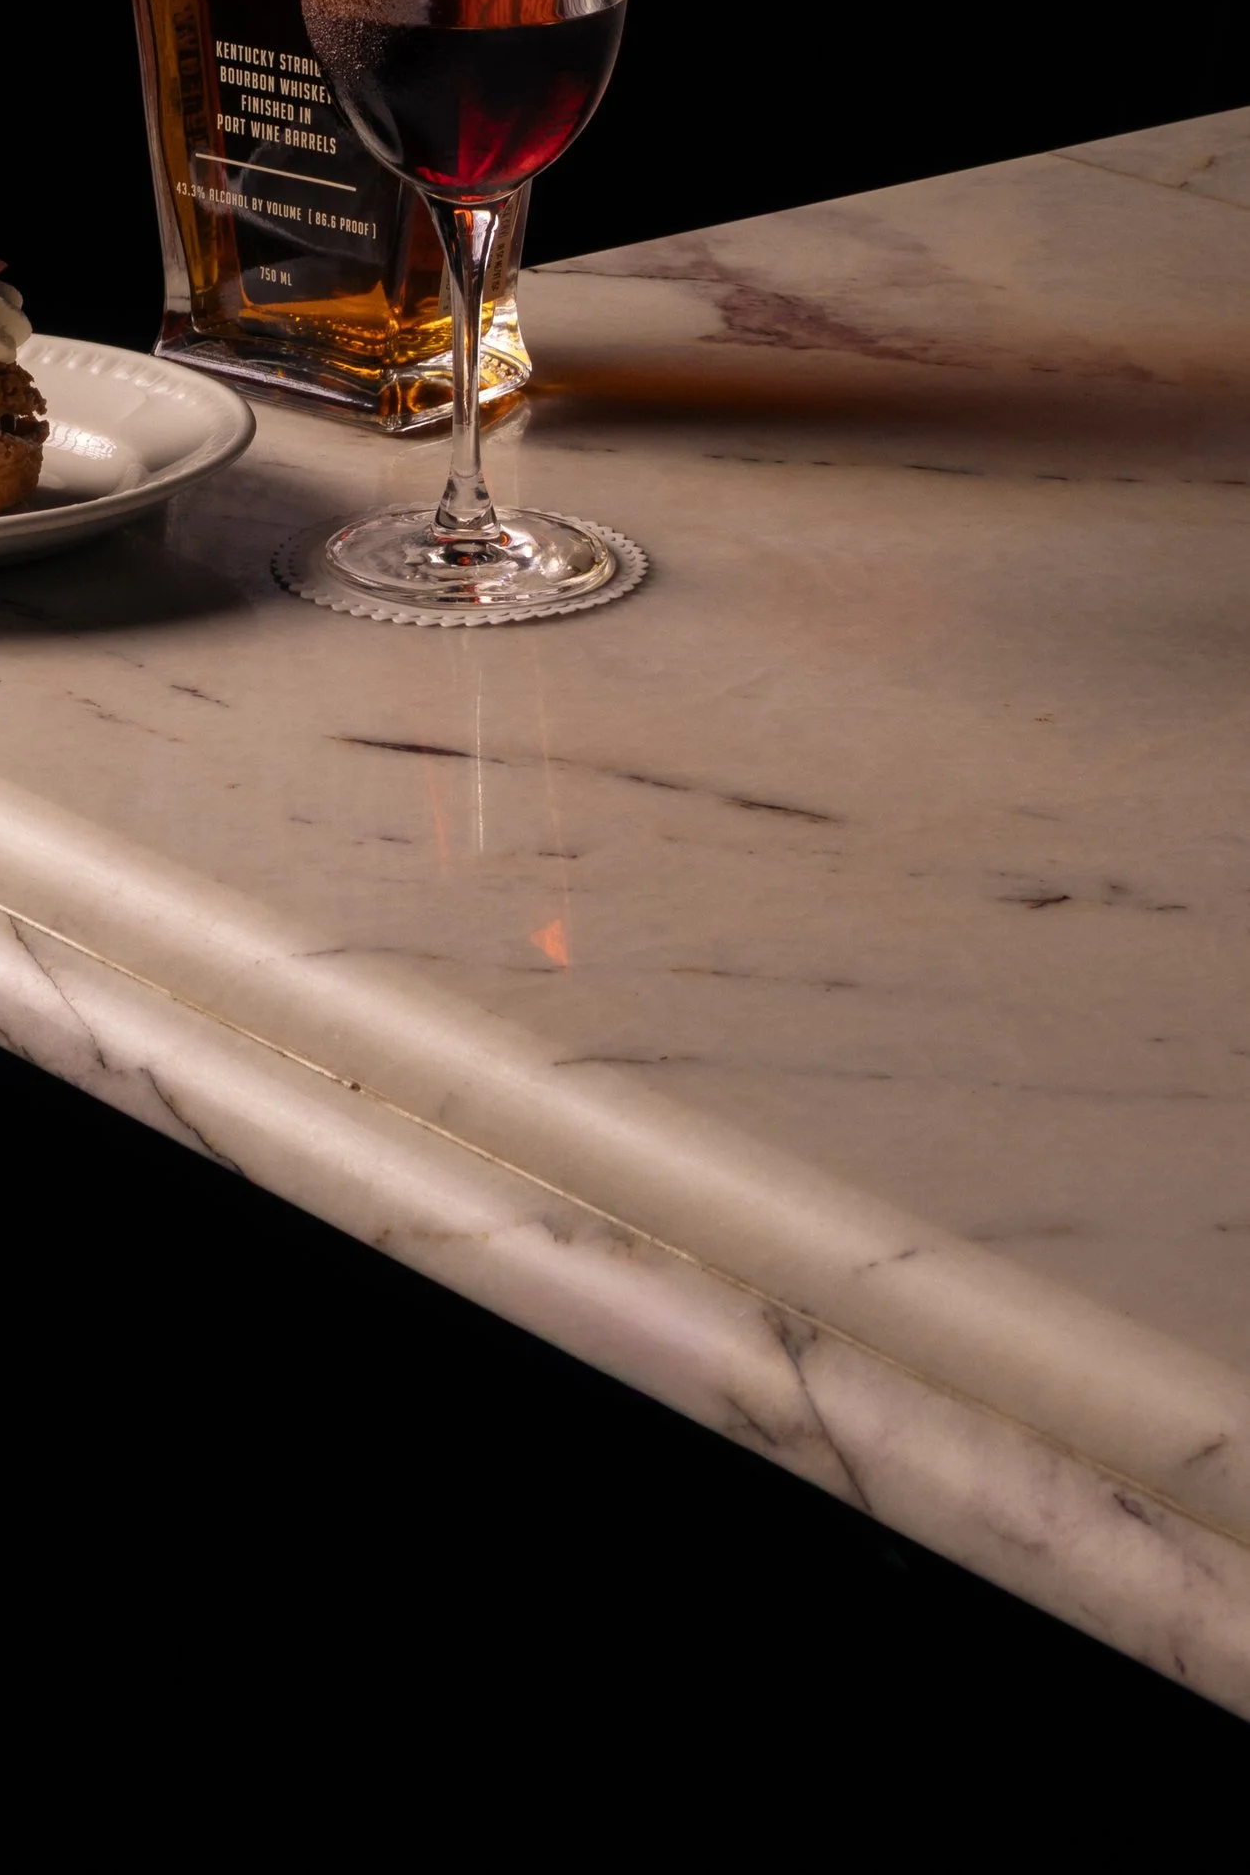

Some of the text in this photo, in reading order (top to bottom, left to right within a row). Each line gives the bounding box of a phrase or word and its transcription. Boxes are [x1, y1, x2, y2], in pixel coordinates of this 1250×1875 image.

[216, 40, 275, 68] KENTUCKY
[220, 66, 275, 93] BOURBON
[241, 95, 311, 125] FINISHED IN
[217, 113, 336, 155] PORT WINE BARRELS
[176, 181, 206, 199] 43.3%
[209, 188, 249, 209] ALCOHOL
[252, 197, 263, 213] BY
[266, 200, 301, 221] VOLUME
[260, 266, 292, 286] 750 ML
